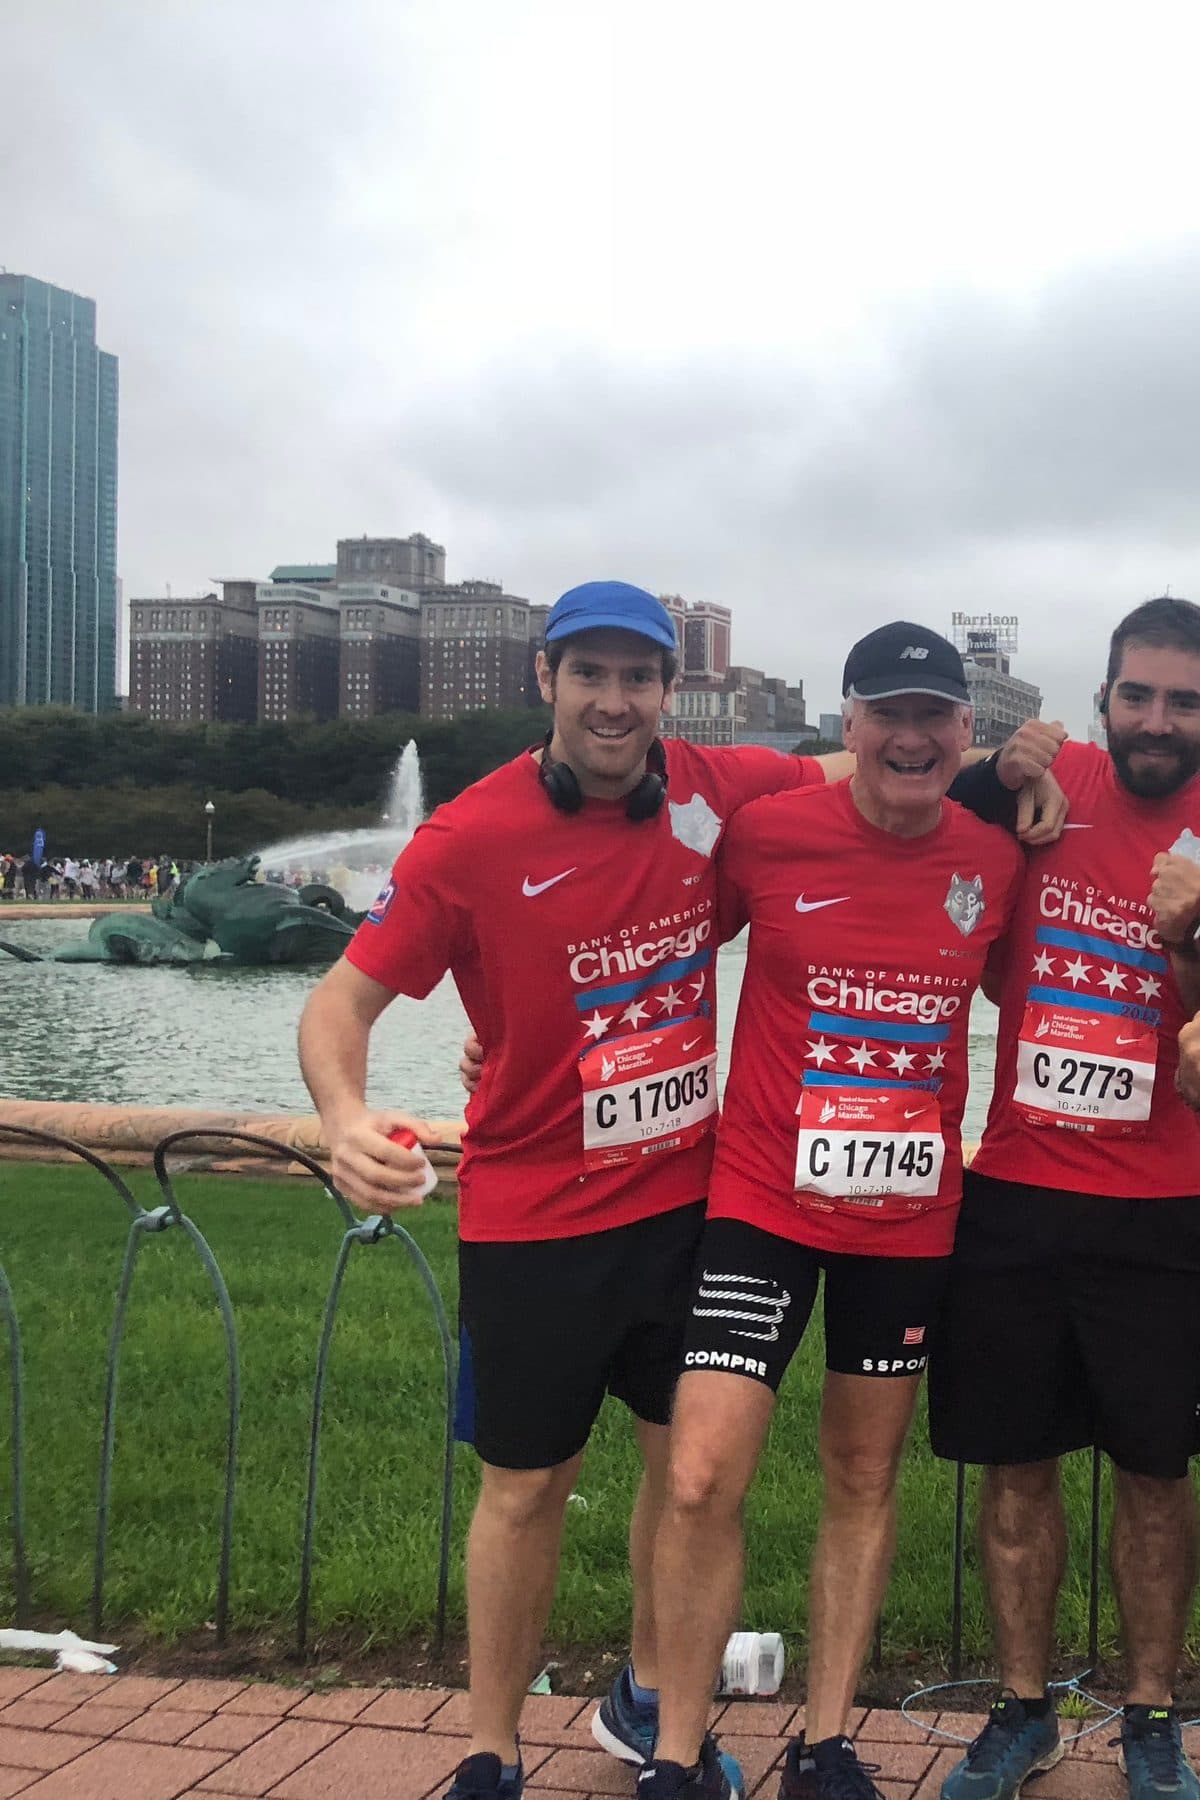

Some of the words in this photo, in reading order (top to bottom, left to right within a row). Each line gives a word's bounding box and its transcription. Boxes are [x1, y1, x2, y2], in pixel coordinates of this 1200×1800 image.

[952, 612, 1018, 625] Harrison
[1042, 874, 1079, 891] BANK
[1086, 886, 1102, 897] OF
[1108, 895, 1153, 916] AMERI
[567, 935, 612, 954] BANK
[619, 925, 640, 938] OF
[648, 899, 712, 931] AMERICA
[1039, 886, 1163, 949] Chicago
[570, 919, 711, 984] Chicago
[808, 965, 855, 978] BANK
[865, 971, 887, 980] OF
[896, 974, 968, 987] AMERICA
[807, 977, 960, 1024] Chicago
[1050, 1029, 1085, 1040] Marathon
[1052, 1020, 1079, 1032] Chicago
[596, 1093, 617, 1128] C
[629, 1064, 709, 1122] 17003
[1034, 1052, 1050, 1088] C
[1057, 1058, 1134, 1101] 2773
[838, 1111, 875, 1120] Marathon
[839, 1104, 868, 1114] Chicago
[809, 1138, 830, 1177] C
[844, 1139, 933, 1177] 17145
[685, 1351, 767, 1377] COMPRE
